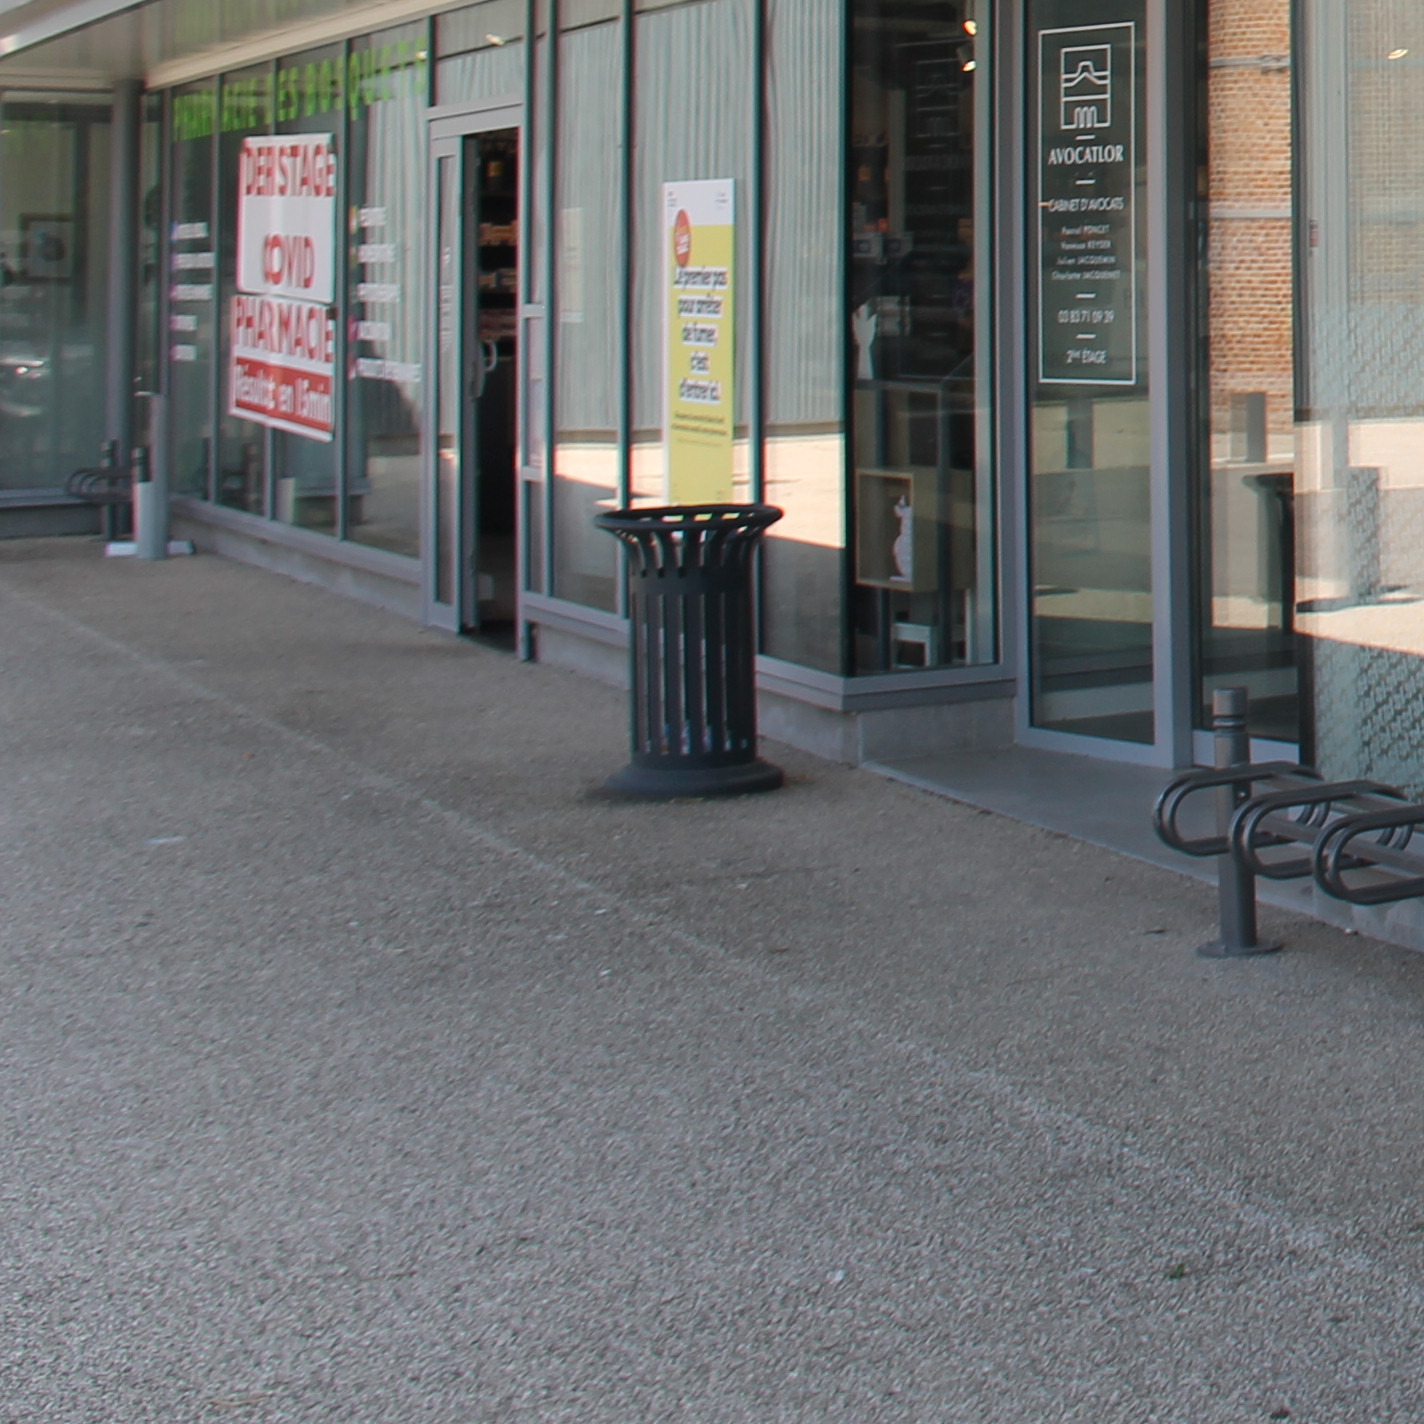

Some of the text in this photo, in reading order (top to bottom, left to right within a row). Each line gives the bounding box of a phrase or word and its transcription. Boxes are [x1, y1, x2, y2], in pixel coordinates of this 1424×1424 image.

[1047, 144, 1124, 166] AVOCATLOR
[263, 233, 316, 289] COVID
[235, 294, 335, 363] PHARMACIE
